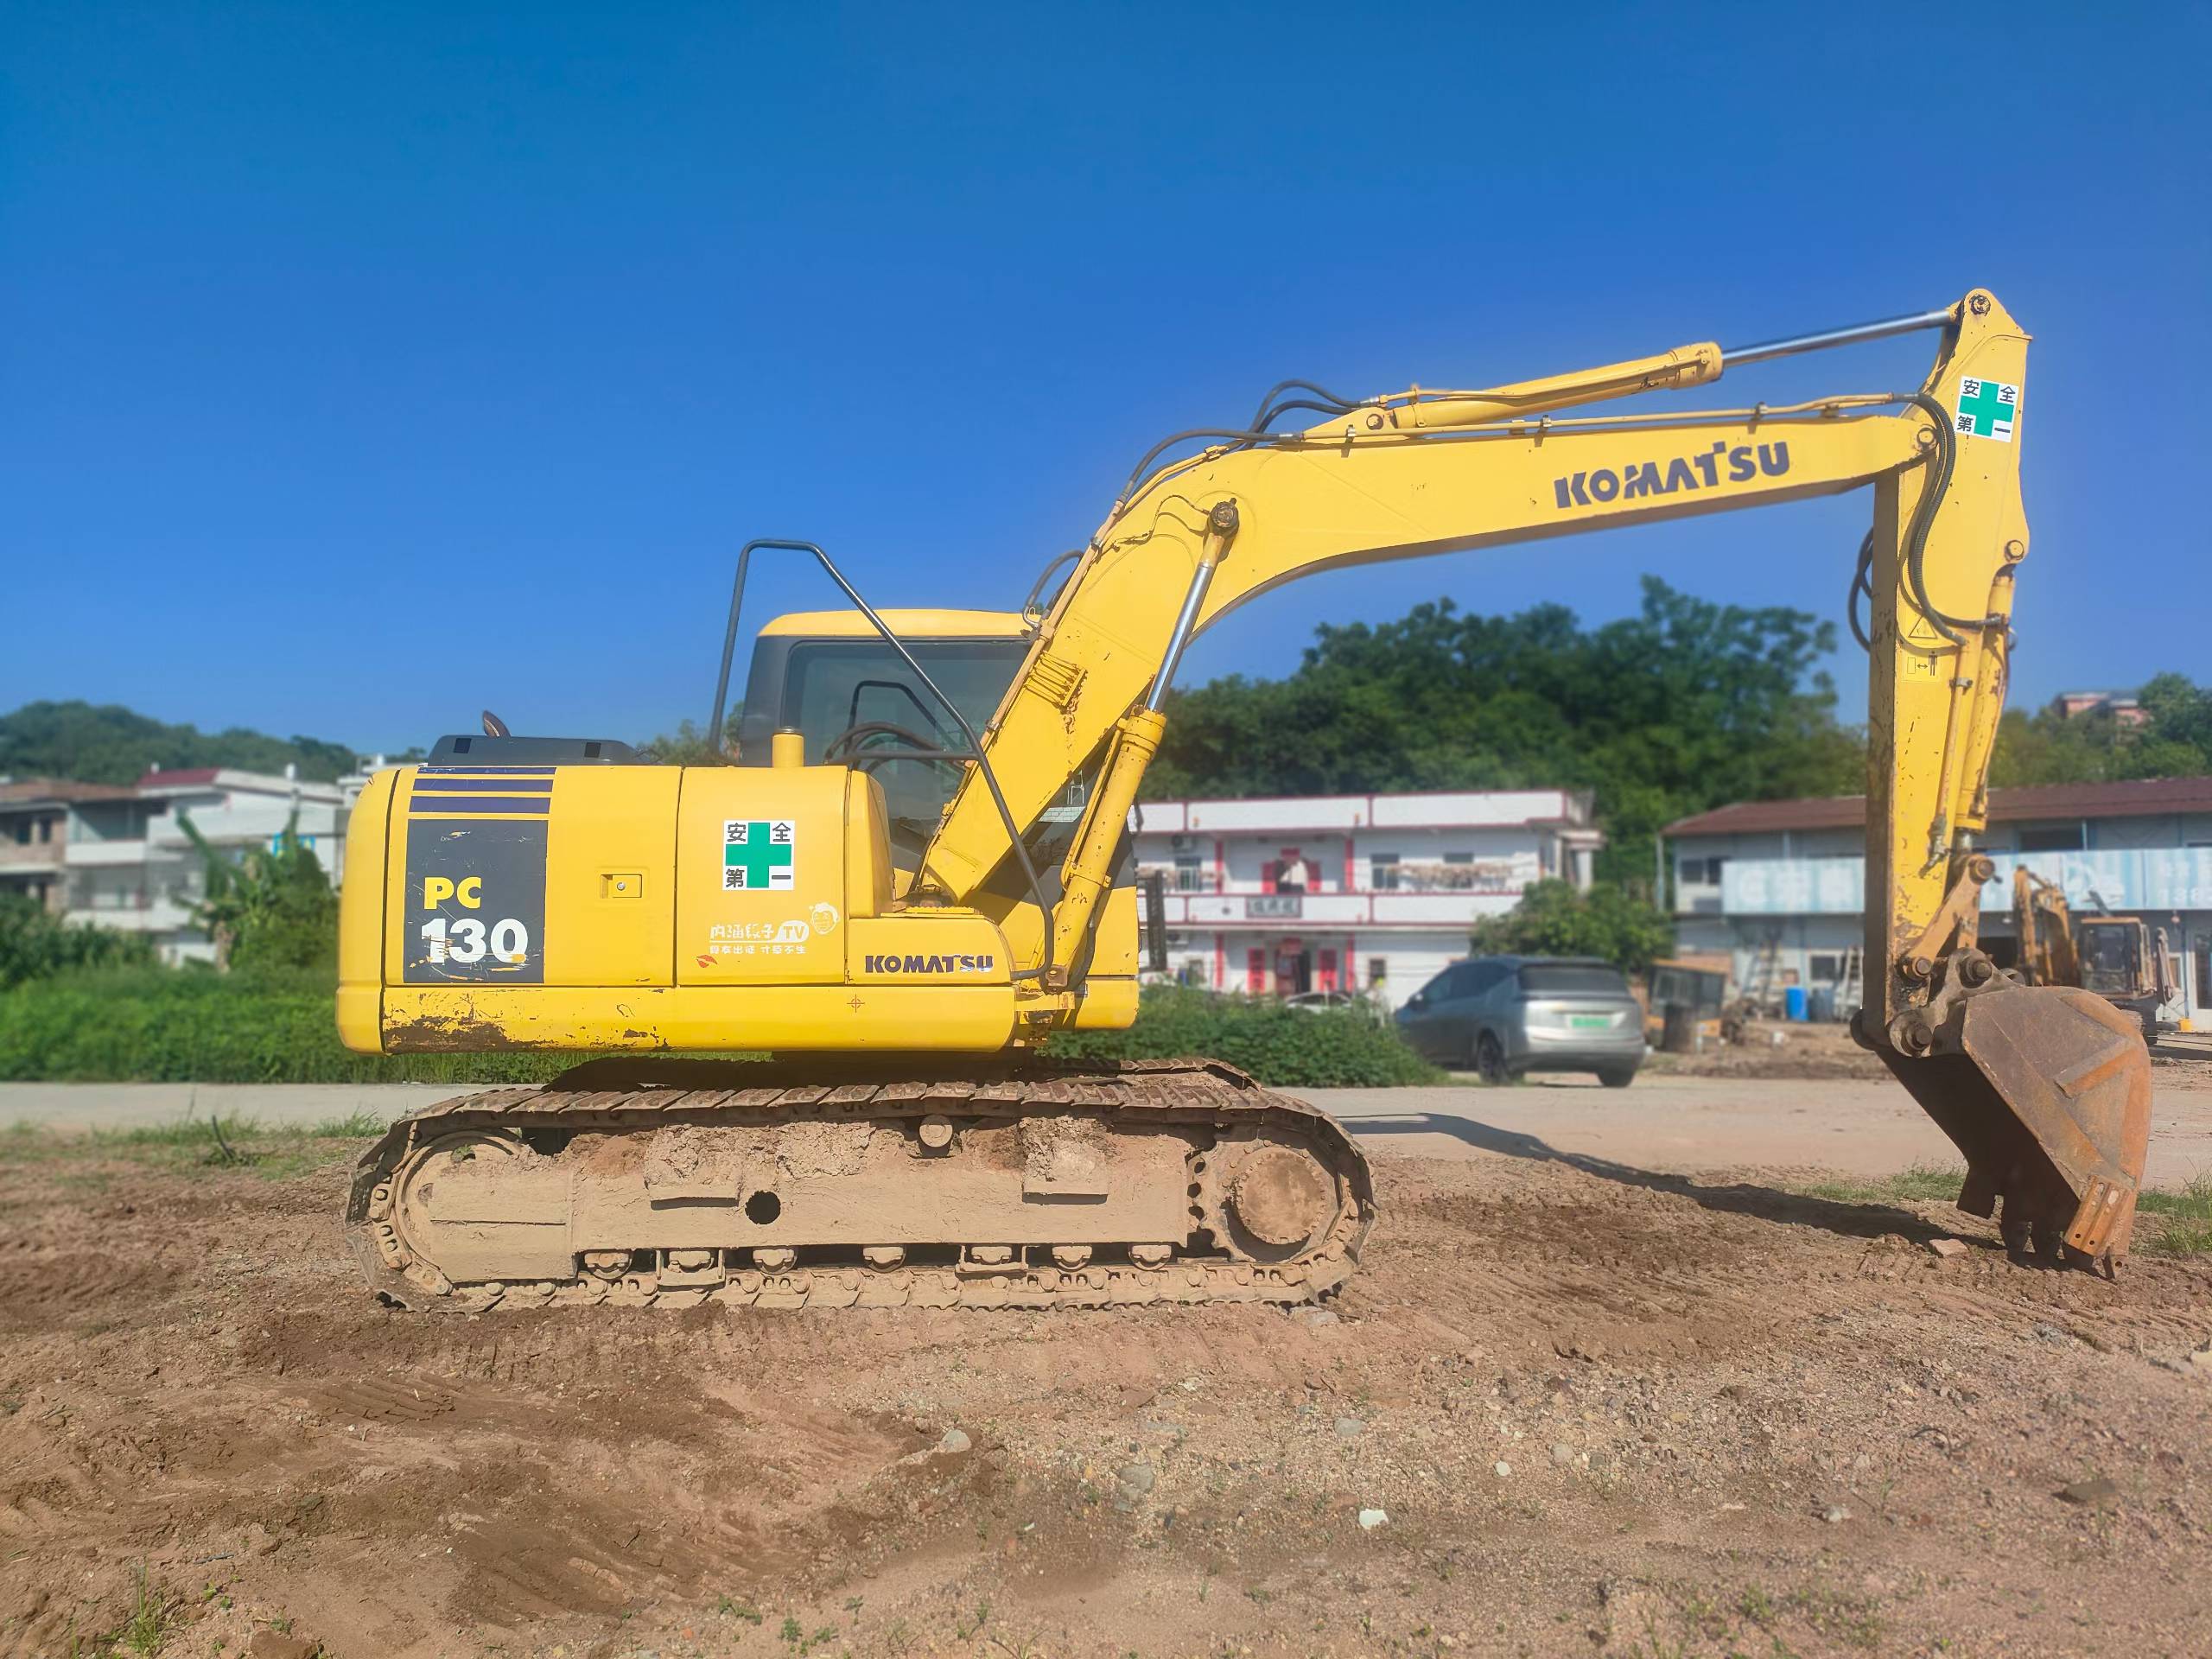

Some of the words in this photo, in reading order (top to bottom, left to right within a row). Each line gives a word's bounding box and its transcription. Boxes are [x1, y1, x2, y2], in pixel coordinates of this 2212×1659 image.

[1962, 379, 2016, 403] 安全
[1957, 415, 2011, 434] 第一
[1554, 441, 1790, 508] KOMATSU
[727, 823, 791, 842] 安全
[726, 868, 791, 887] 第一
[424, 877, 481, 910] PC
[421, 918, 528, 963] 130
[783, 925, 805, 940] TV
[865, 954, 993, 973] KOMATSU
